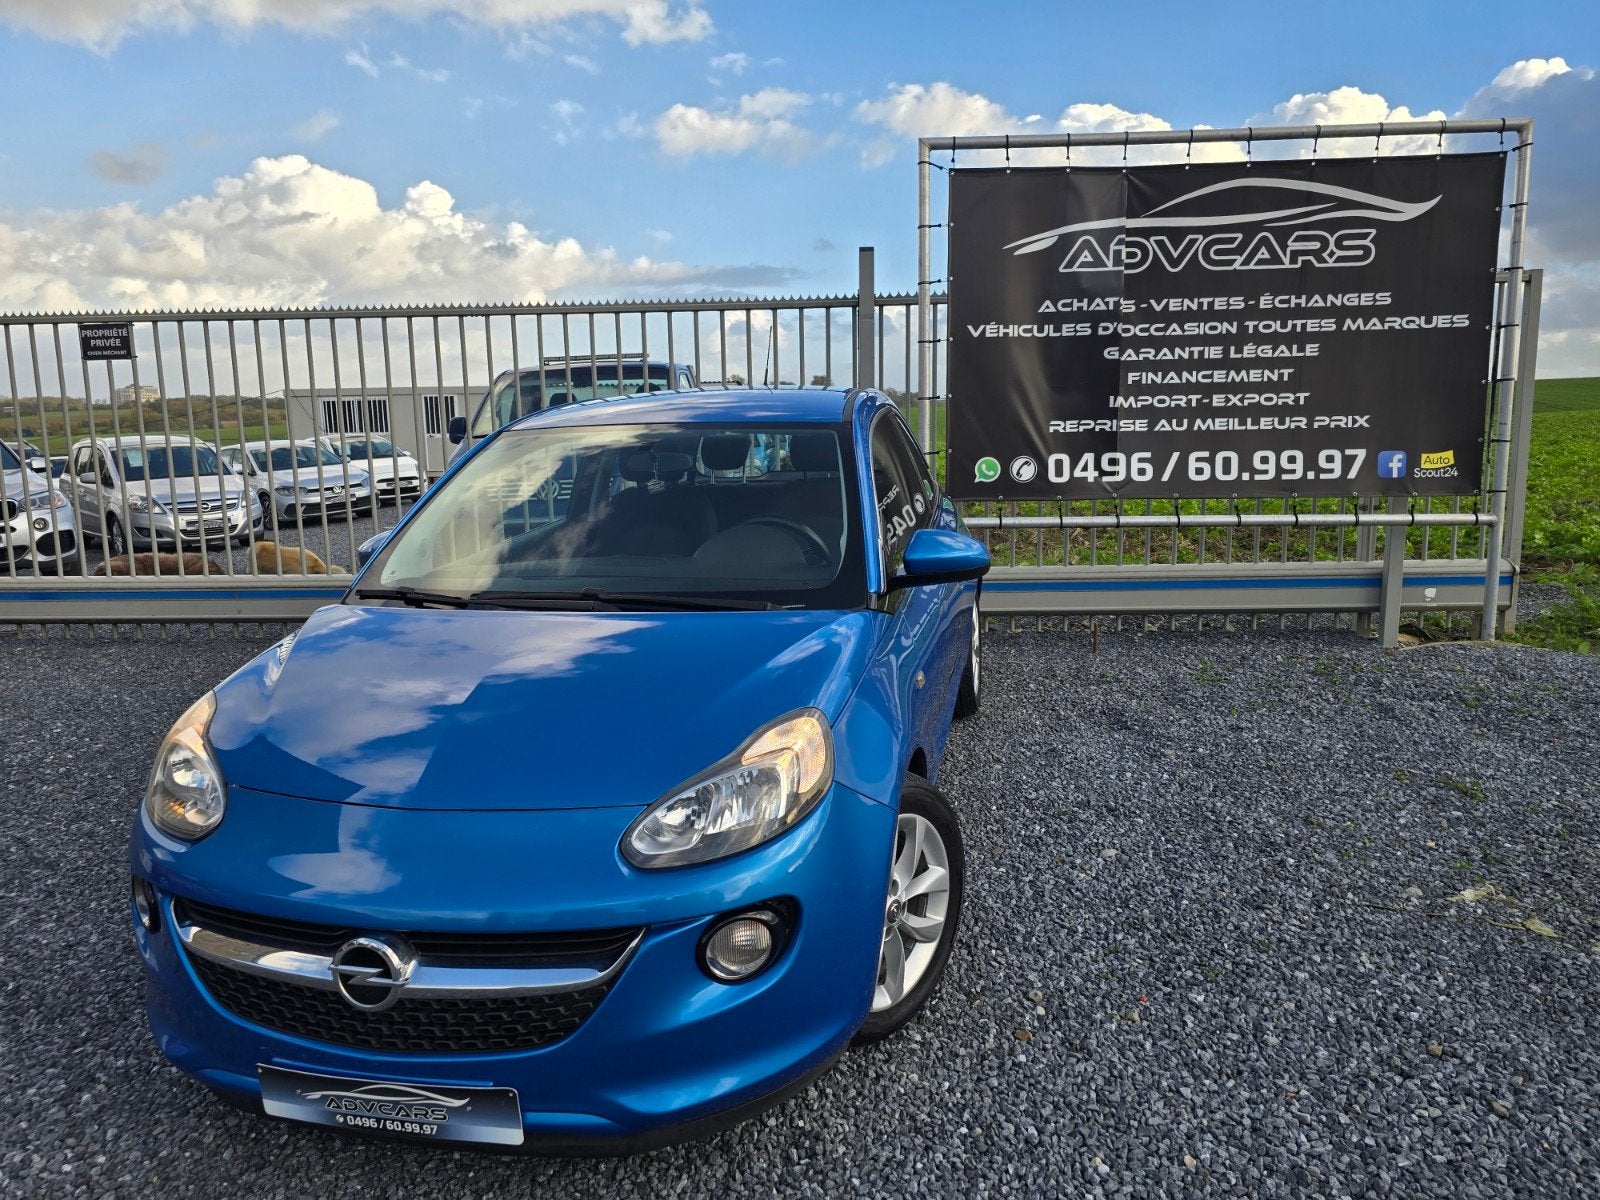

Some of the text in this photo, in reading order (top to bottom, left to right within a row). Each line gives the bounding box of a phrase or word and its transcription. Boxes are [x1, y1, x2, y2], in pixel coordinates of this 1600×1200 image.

[1058, 228, 1377, 273] ADVCARS
[81, 327, 128, 338] PROPRIÉTÉ
[966, 313, 1470, 339] VÉHICULES D'OCCASION TOUTES MARQUES
[90, 337, 122, 347] PRIVÉE
[1103, 342, 1320, 361] GARANTIE LÉGALE
[1127, 368, 1295, 385] FINANCEMENT
[1109, 392, 1311, 410] IMPORT-EXPORT
[1049, 414, 1370, 433] REPRISE AU MEILLEUR PRIX
[1047, 452, 1154, 484] 0496
[1187, 448, 1367, 482] 60.99.97
[1423, 455, 1451, 465] Auto
[1413, 466, 1459, 478] Scout24
[325, 1096, 449, 1122] ADVCARS
[346, 1114, 379, 1129] 0496
[385, 1120, 438, 1136] 60.99.97
